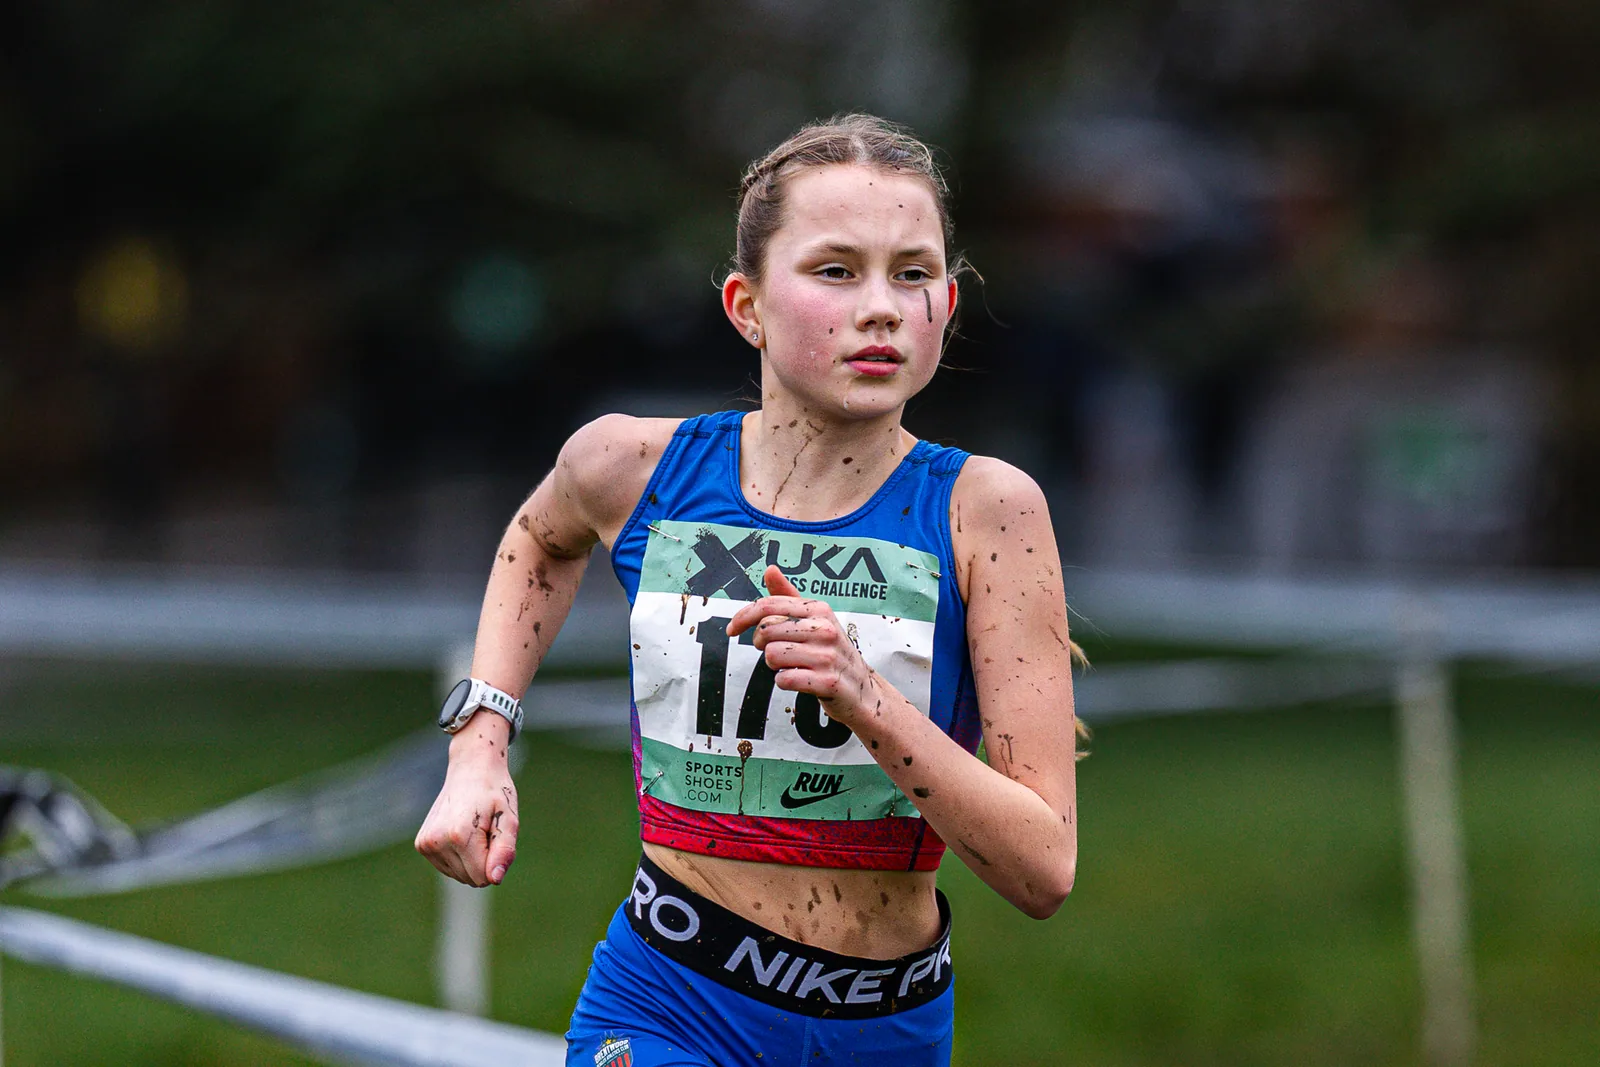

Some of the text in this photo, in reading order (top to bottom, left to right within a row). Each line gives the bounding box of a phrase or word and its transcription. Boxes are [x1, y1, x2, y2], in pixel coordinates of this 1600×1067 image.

[765, 539, 888, 584] UKA
[810, 579, 888, 601] CHALLENGE
[685, 761, 743, 778] SPORTS
[684, 774, 733, 791] SHOES
[792, 771, 845, 794] RUN
[684, 789, 722, 804] .COM
[723, 935, 897, 1004] NIKE
